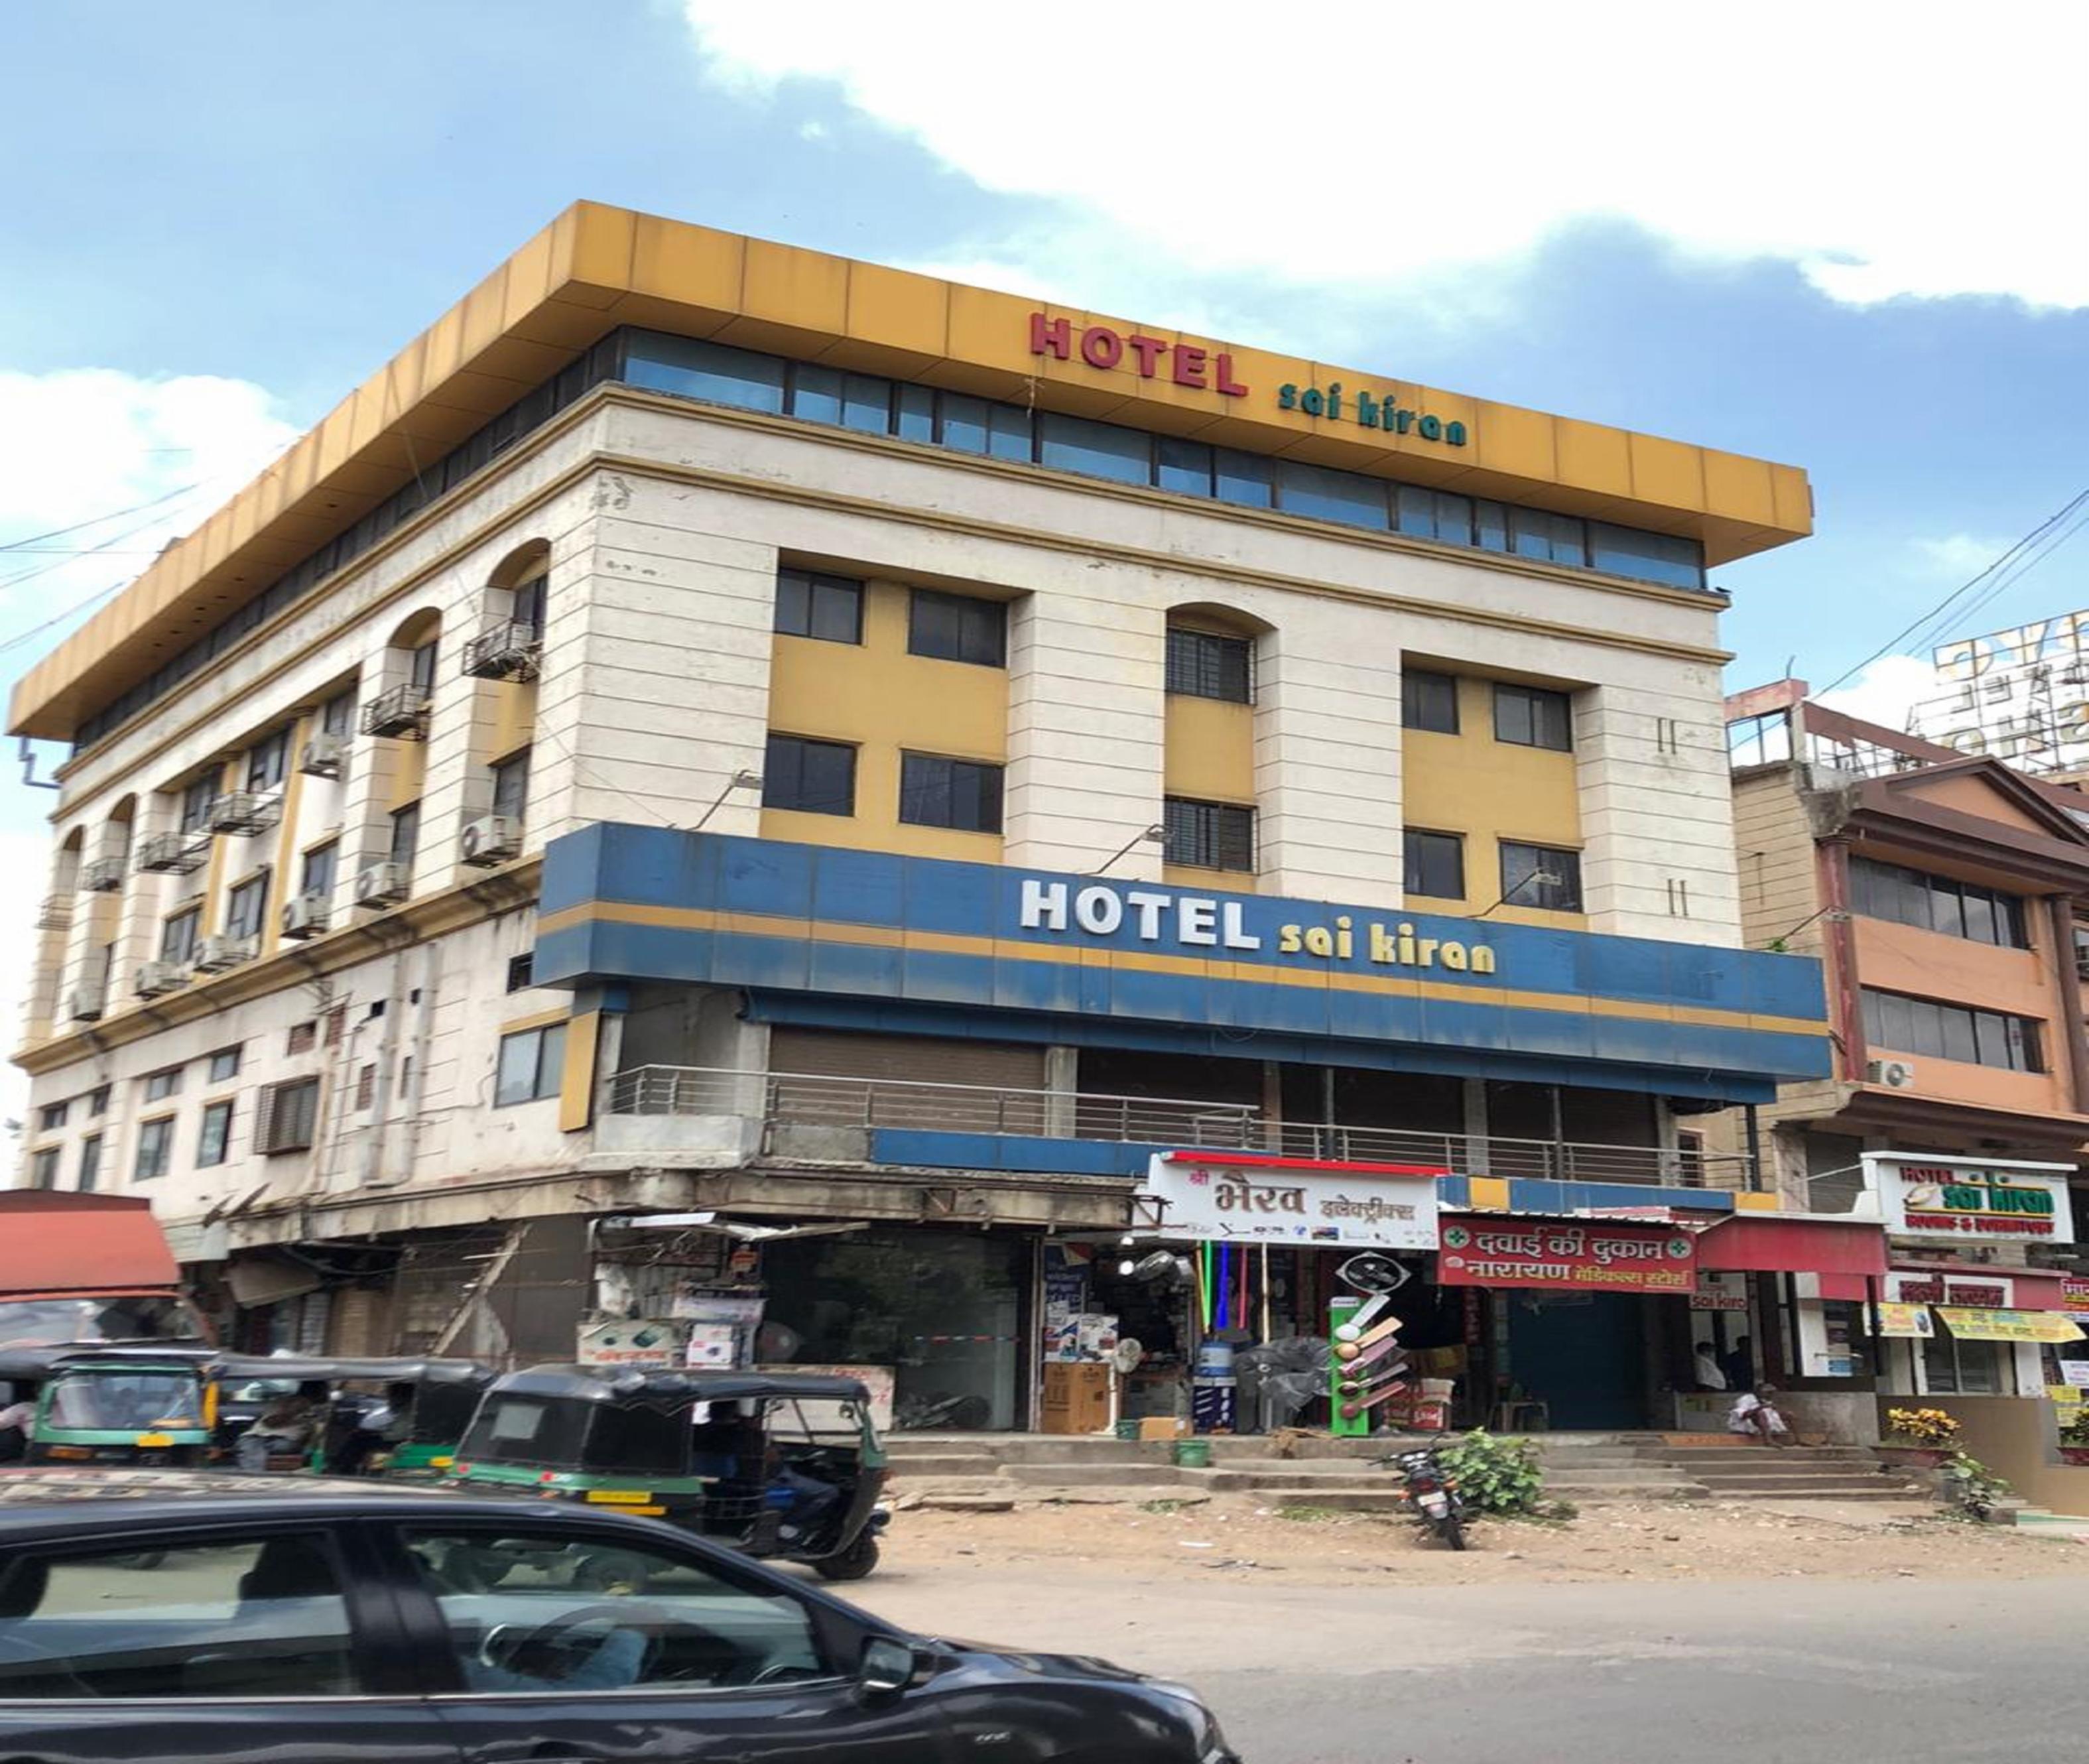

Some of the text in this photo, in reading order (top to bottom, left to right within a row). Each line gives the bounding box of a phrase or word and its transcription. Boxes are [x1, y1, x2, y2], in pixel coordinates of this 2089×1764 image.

[1031, 312, 1468, 446] HOTEL sai kiran
[1021, 879, 1496, 974] HOTEL sai kiran
[1215, 1170, 1307, 1214] भैरव
[1900, 1167, 1960, 1186] HOTEL
[1476, 1227, 1663, 1264] दवाई की दुकान
[1466, 1260, 1570, 1281] नारायण
